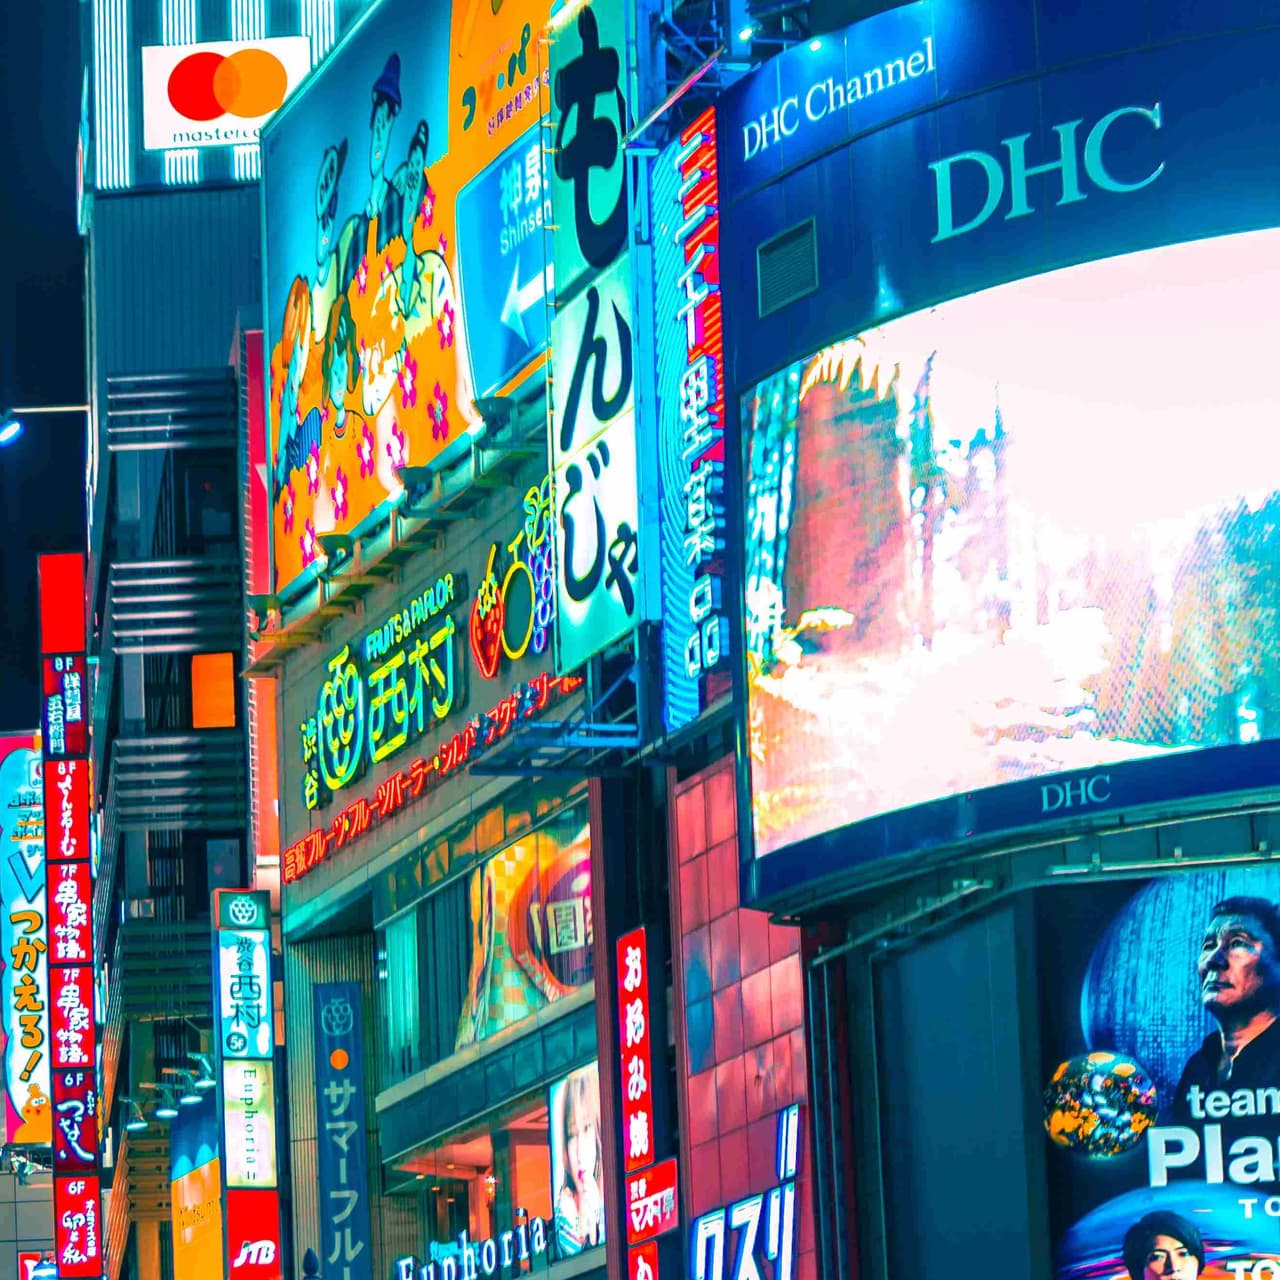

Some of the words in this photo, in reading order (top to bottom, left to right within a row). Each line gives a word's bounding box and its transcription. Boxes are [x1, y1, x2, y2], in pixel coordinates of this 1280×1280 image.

[742, 98, 799, 163] DHC
[804, 36, 937, 124] Channel
[928, 101, 1166, 245] DHC
[554, 4, 638, 613] もんじゃ
[1040, 774, 1112, 813] DHC
[60, 864, 78, 878] 7F
[62, 969, 80, 982] 7F
[623, 944, 648, 1158] お好み焼
[64, 1073, 84, 1087] 6F
[240, 1068, 259, 1165] Euphoria
[1148, 1124, 1280, 1188] Pla
[67, 1180, 85, 1195] 6F
[233, 1239, 276, 1268] JTB
